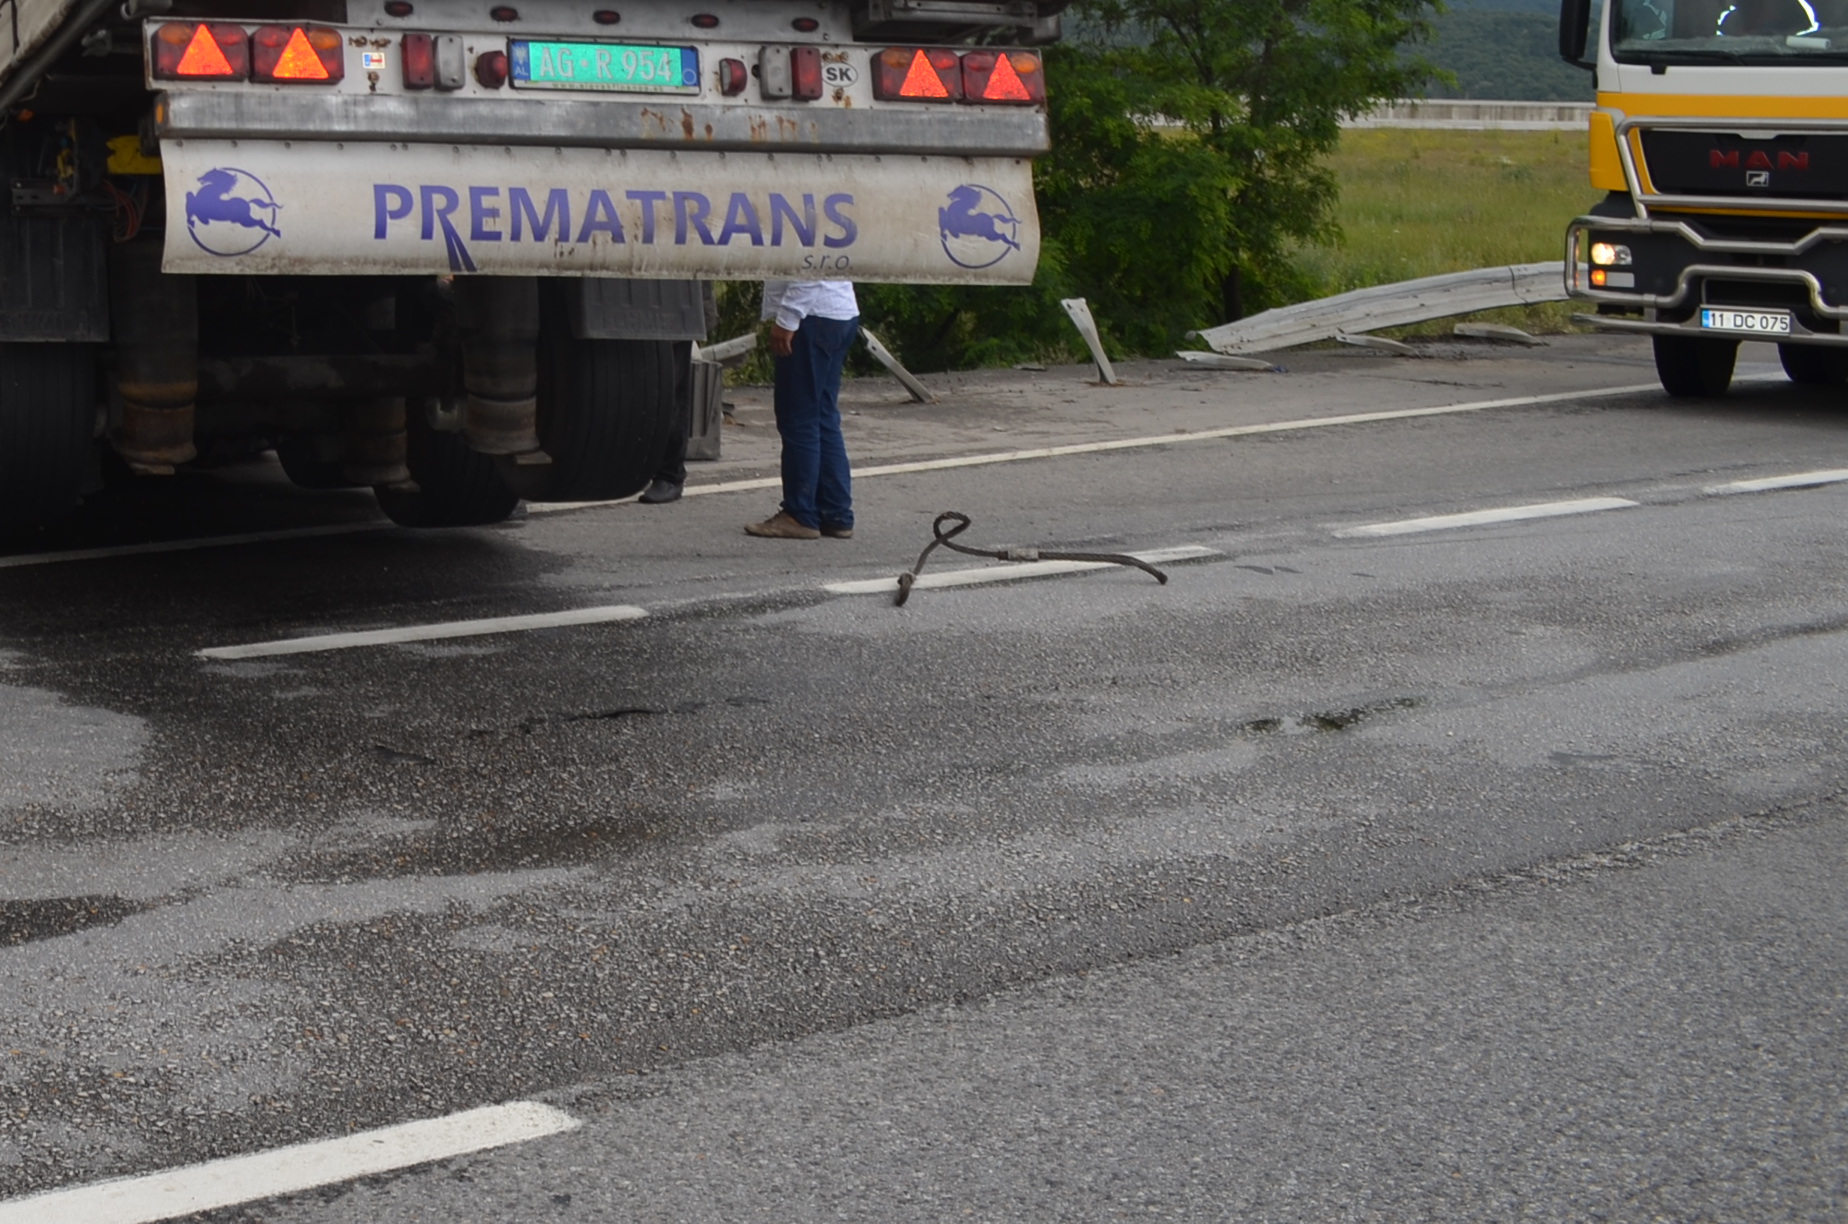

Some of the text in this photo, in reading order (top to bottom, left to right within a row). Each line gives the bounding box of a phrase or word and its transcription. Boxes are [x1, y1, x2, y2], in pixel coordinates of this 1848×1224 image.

[825, 66, 853, 82] SK
[1710, 149, 1809, 170] MAN
[372, 184, 859, 273] PREMATRANS
[1710, 313, 1789, 331] 11 DC 075
